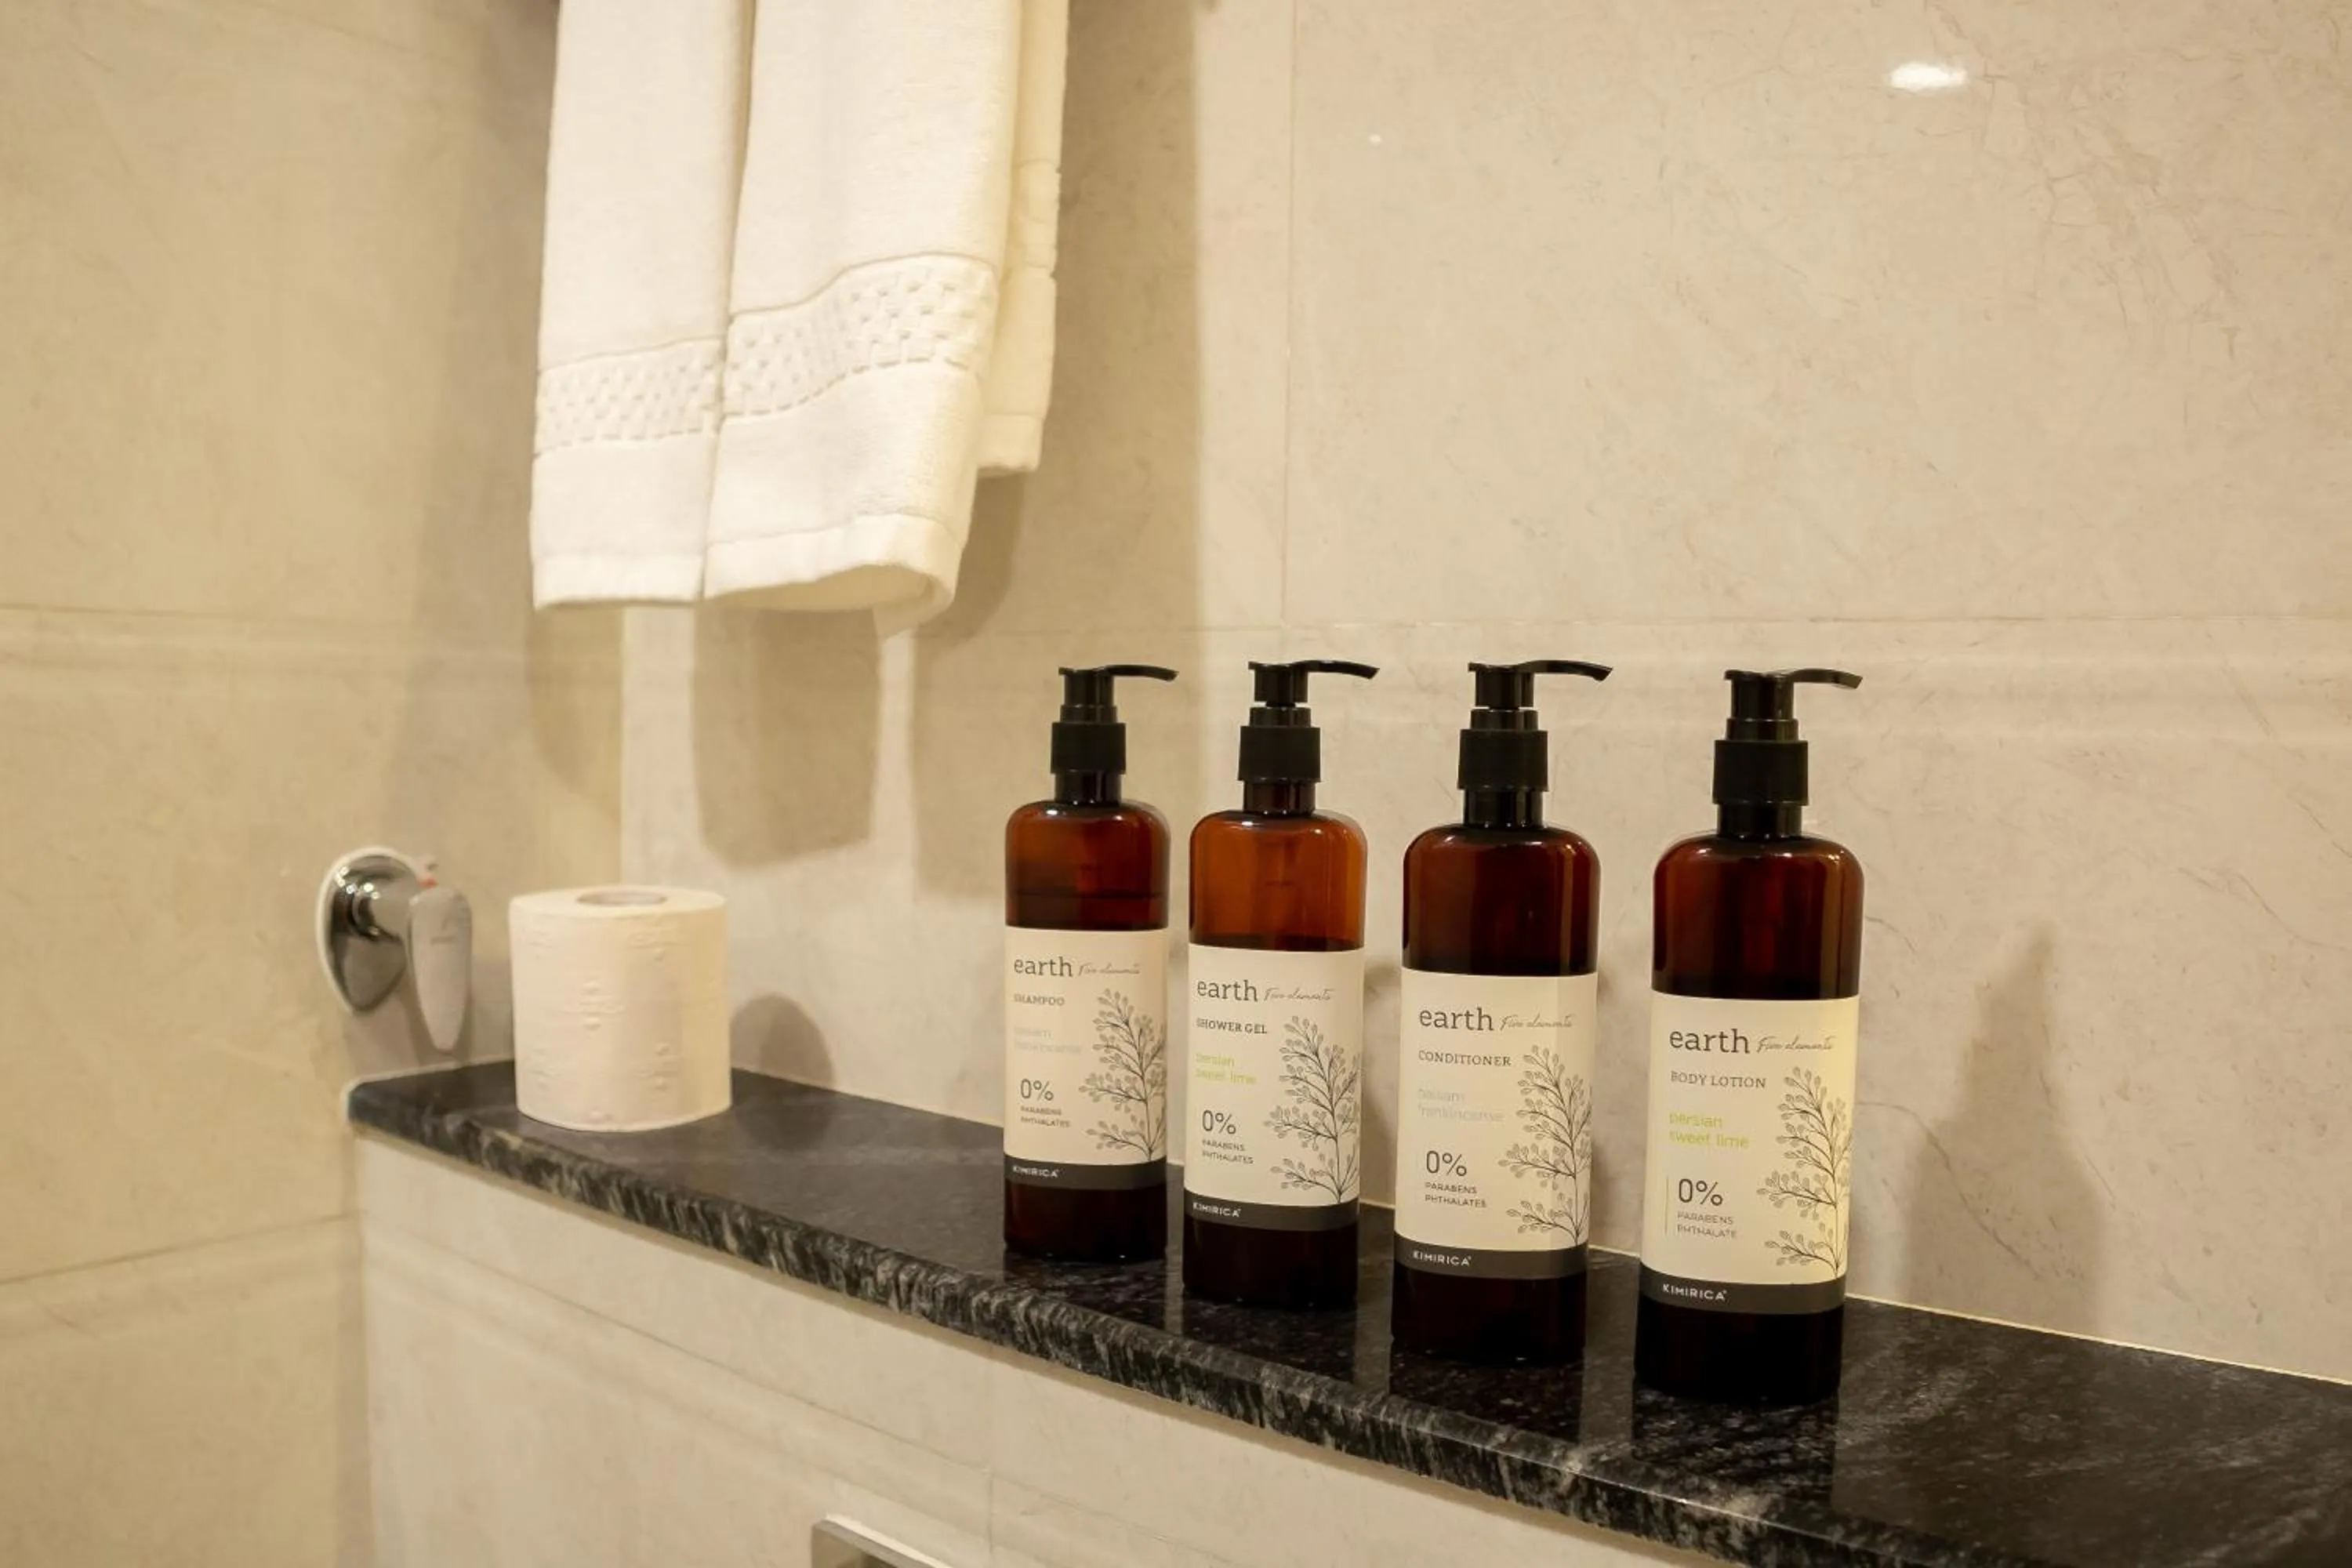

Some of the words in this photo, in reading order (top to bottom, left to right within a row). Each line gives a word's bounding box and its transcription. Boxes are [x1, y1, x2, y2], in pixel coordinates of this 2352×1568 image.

[1014, 956, 1073, 978] earth
[1196, 979, 1258, 1002] earth
[1014, 993, 1065, 1007] SHAMPOO
[1196, 1017, 1242, 1033] SHOWER
[1244, 1022, 1268, 1035] GEL
[1419, 1007, 1494, 1032] earth
[1669, 1029, 1751, 1054] earth
[1418, 1050, 1512, 1067] CONDITIONER
[1671, 1070, 1708, 1086] BODY
[1711, 1074, 1767, 1089] LOTION
[1020, 1078, 1054, 1102] 0%
[1202, 1109, 1236, 1135] 0%
[1669, 1112, 1723, 1129] persian
[1715, 1132, 1750, 1149] lime
[1426, 1149, 1468, 1177] 0%
[1425, 1181, 1478, 1195] PARABENS
[1678, 1178, 1723, 1207] 0%
[1192, 1201, 1240, 1218] KIMIRICA
[1425, 1194, 1487, 1209] PHTHALATES
[1677, 1210, 1733, 1225] PARABENS
[1414, 1251, 1472, 1267] KIMIRICA
[1662, 1283, 1727, 1301] KIMIRICA
